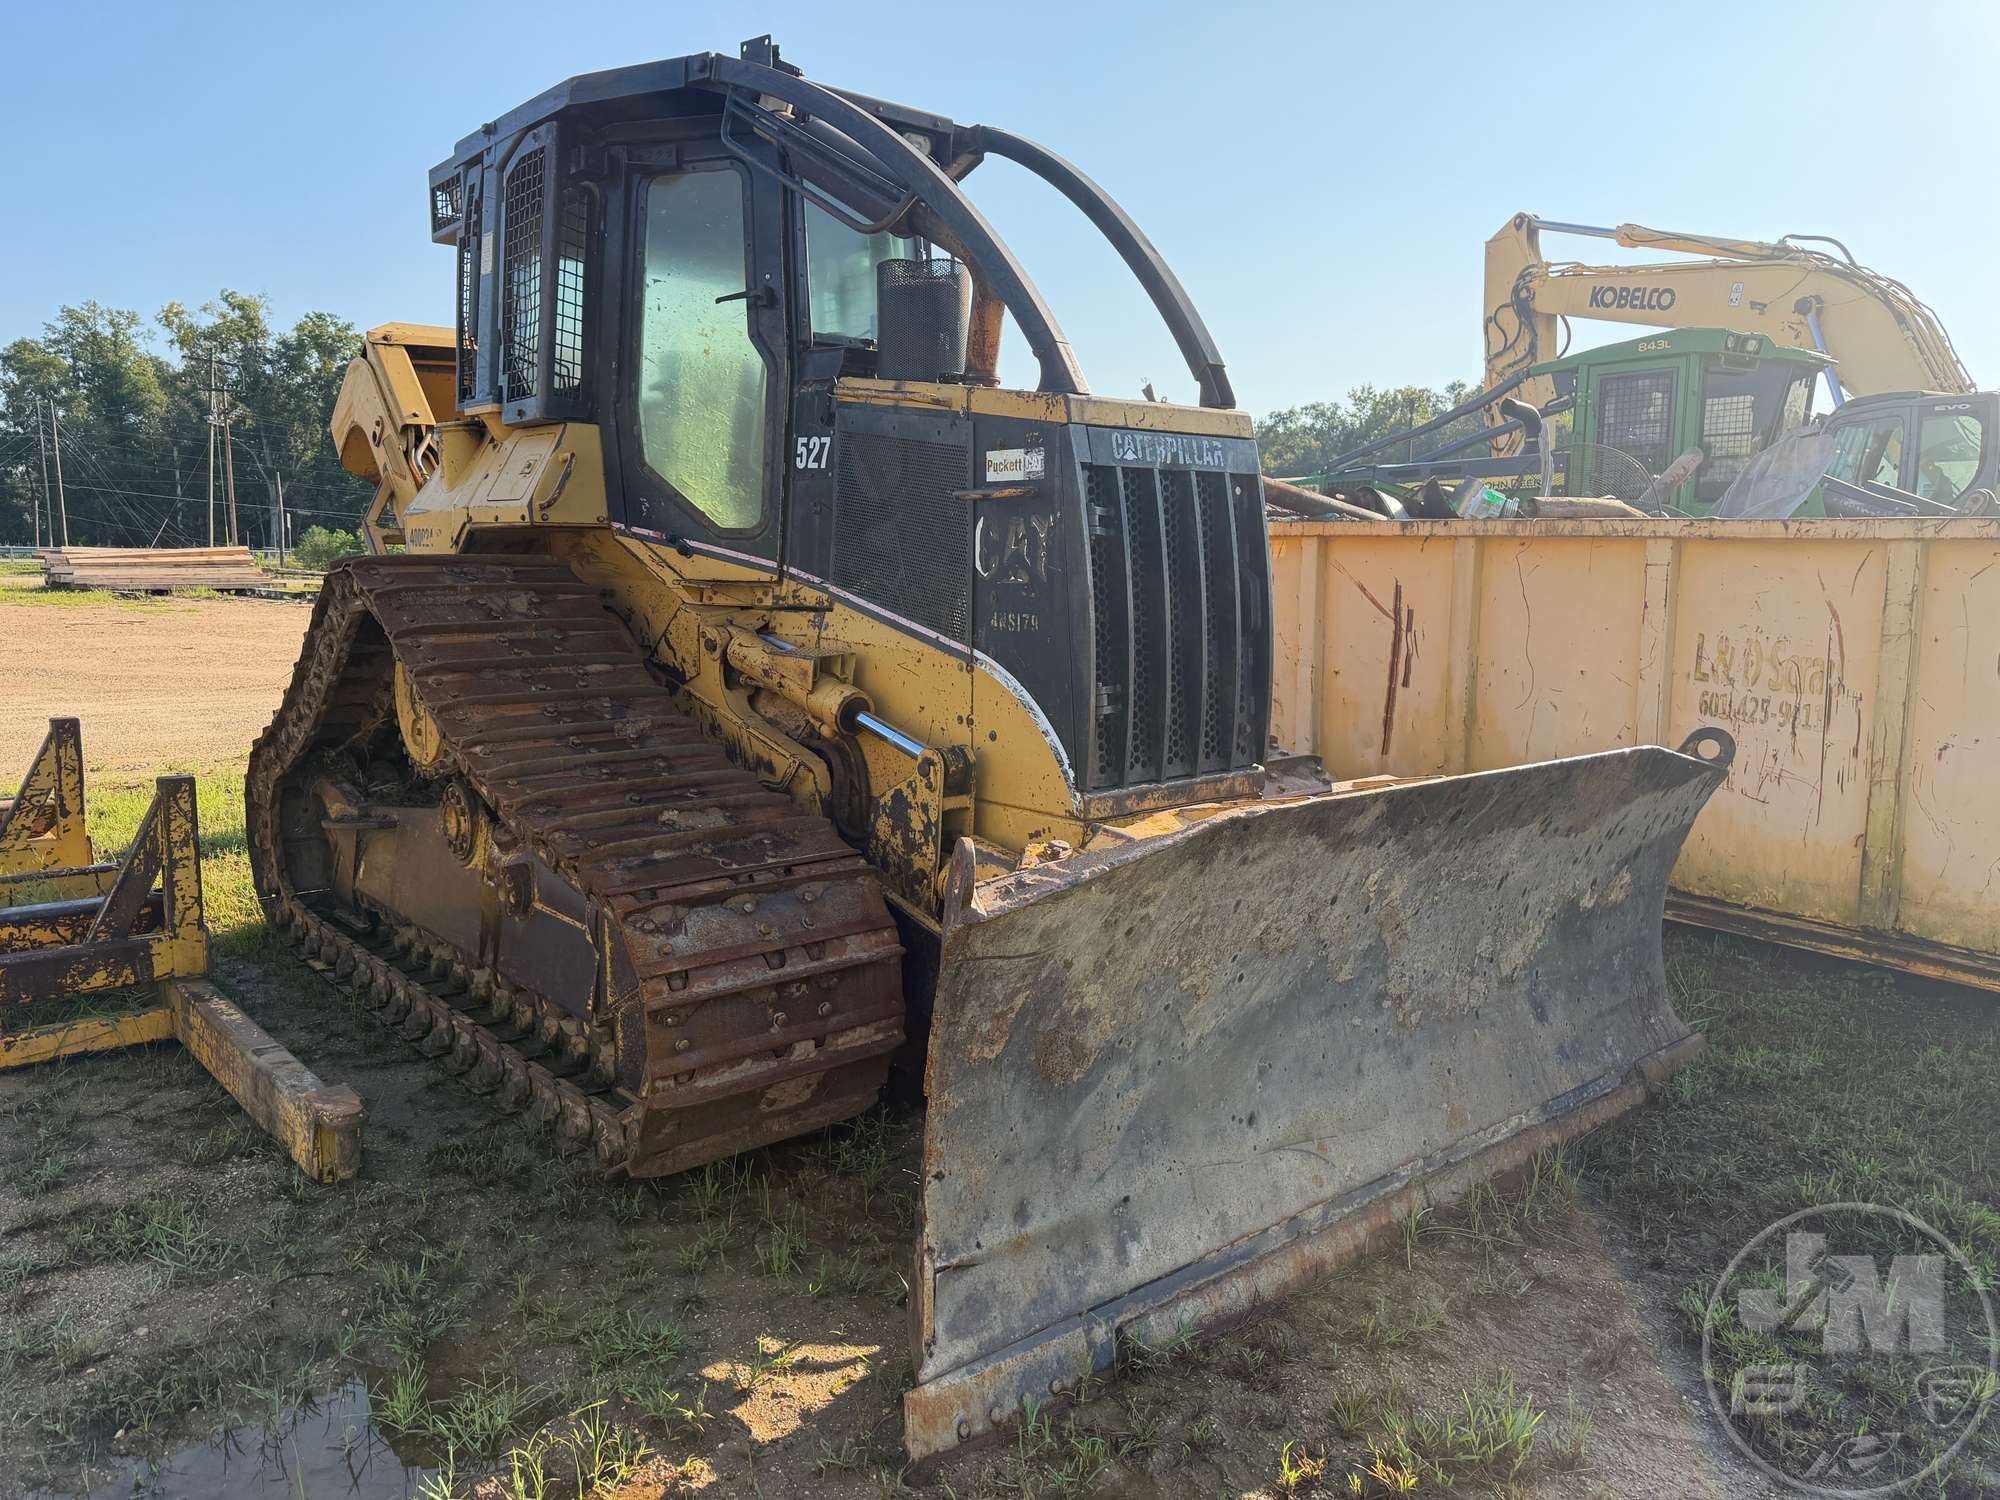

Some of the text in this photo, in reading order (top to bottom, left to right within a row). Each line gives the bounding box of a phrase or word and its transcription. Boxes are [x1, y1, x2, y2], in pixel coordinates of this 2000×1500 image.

[1588, 285, 1677, 312] KOBELCO
[1638, 339, 1672, 352] 843L
[795, 435, 831, 469] 527
[1111, 430, 1225, 468] CATERPILLAR
[986, 458, 1023, 473] Puckett
[1483, 481, 1510, 491] OHN
